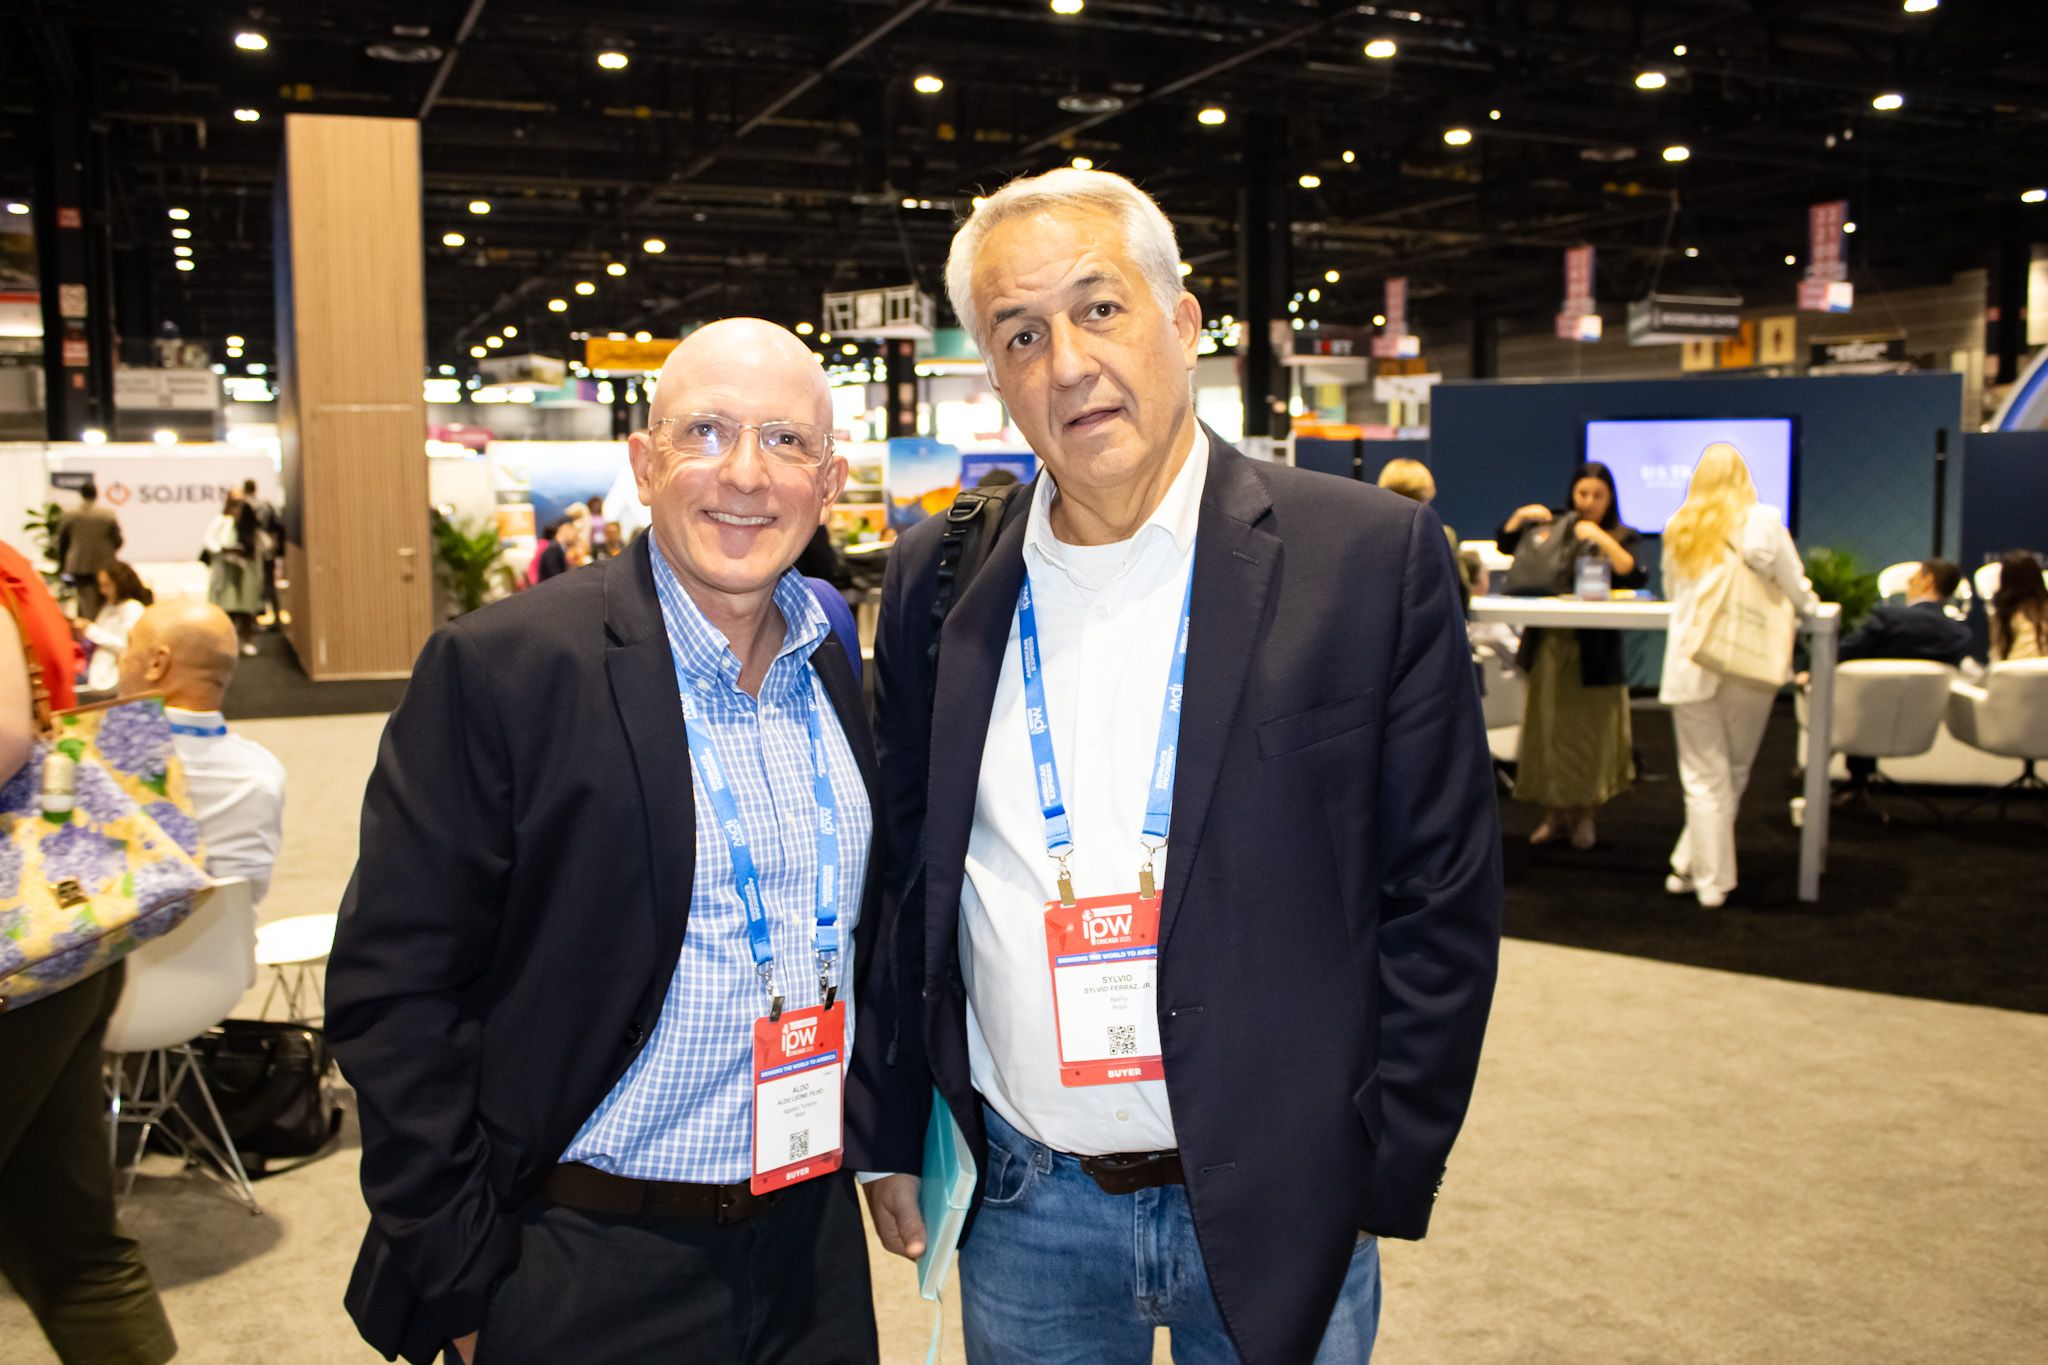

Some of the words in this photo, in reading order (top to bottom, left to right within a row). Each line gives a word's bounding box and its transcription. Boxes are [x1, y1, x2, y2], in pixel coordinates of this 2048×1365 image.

[1023, 639, 1032, 678] AMERICAN
[1028, 635, 1037, 672] EXPRESS
[700, 754, 719, 792] EXPRESS
[703, 747, 724, 790] AMERICAN
[1039, 763, 1051, 807] AMERICAN
[1044, 761, 1056, 800] EXPRESS
[1155, 750, 1168, 790] EXPRESS
[1162, 744, 1175, 790] AMERICAN
[744, 884, 758, 922] EXPRESS
[748, 877, 762, 920] AMERICAN
[1082, 910, 1133, 946] ipw
[1096, 937, 1118, 945] CHICAGO
[1119, 935, 1131, 943] 2025
[1057, 955, 1088, 964] BRINGING
[1089, 953, 1102, 961] THE
[1102, 951, 1126, 960] WORLD
[1137, 948, 1157, 956] AMERI
[1084, 986, 1109, 994] SYLVIO
[1102, 974, 1133, 983] SYLVIO
[781, 1023, 817, 1057] ipw
[792, 1083, 809, 1093] ALDO
[1108, 1068, 1142, 1078] BUYER
[777, 1097, 792, 1105] ALDO
[786, 1167, 810, 1180] BUYER
